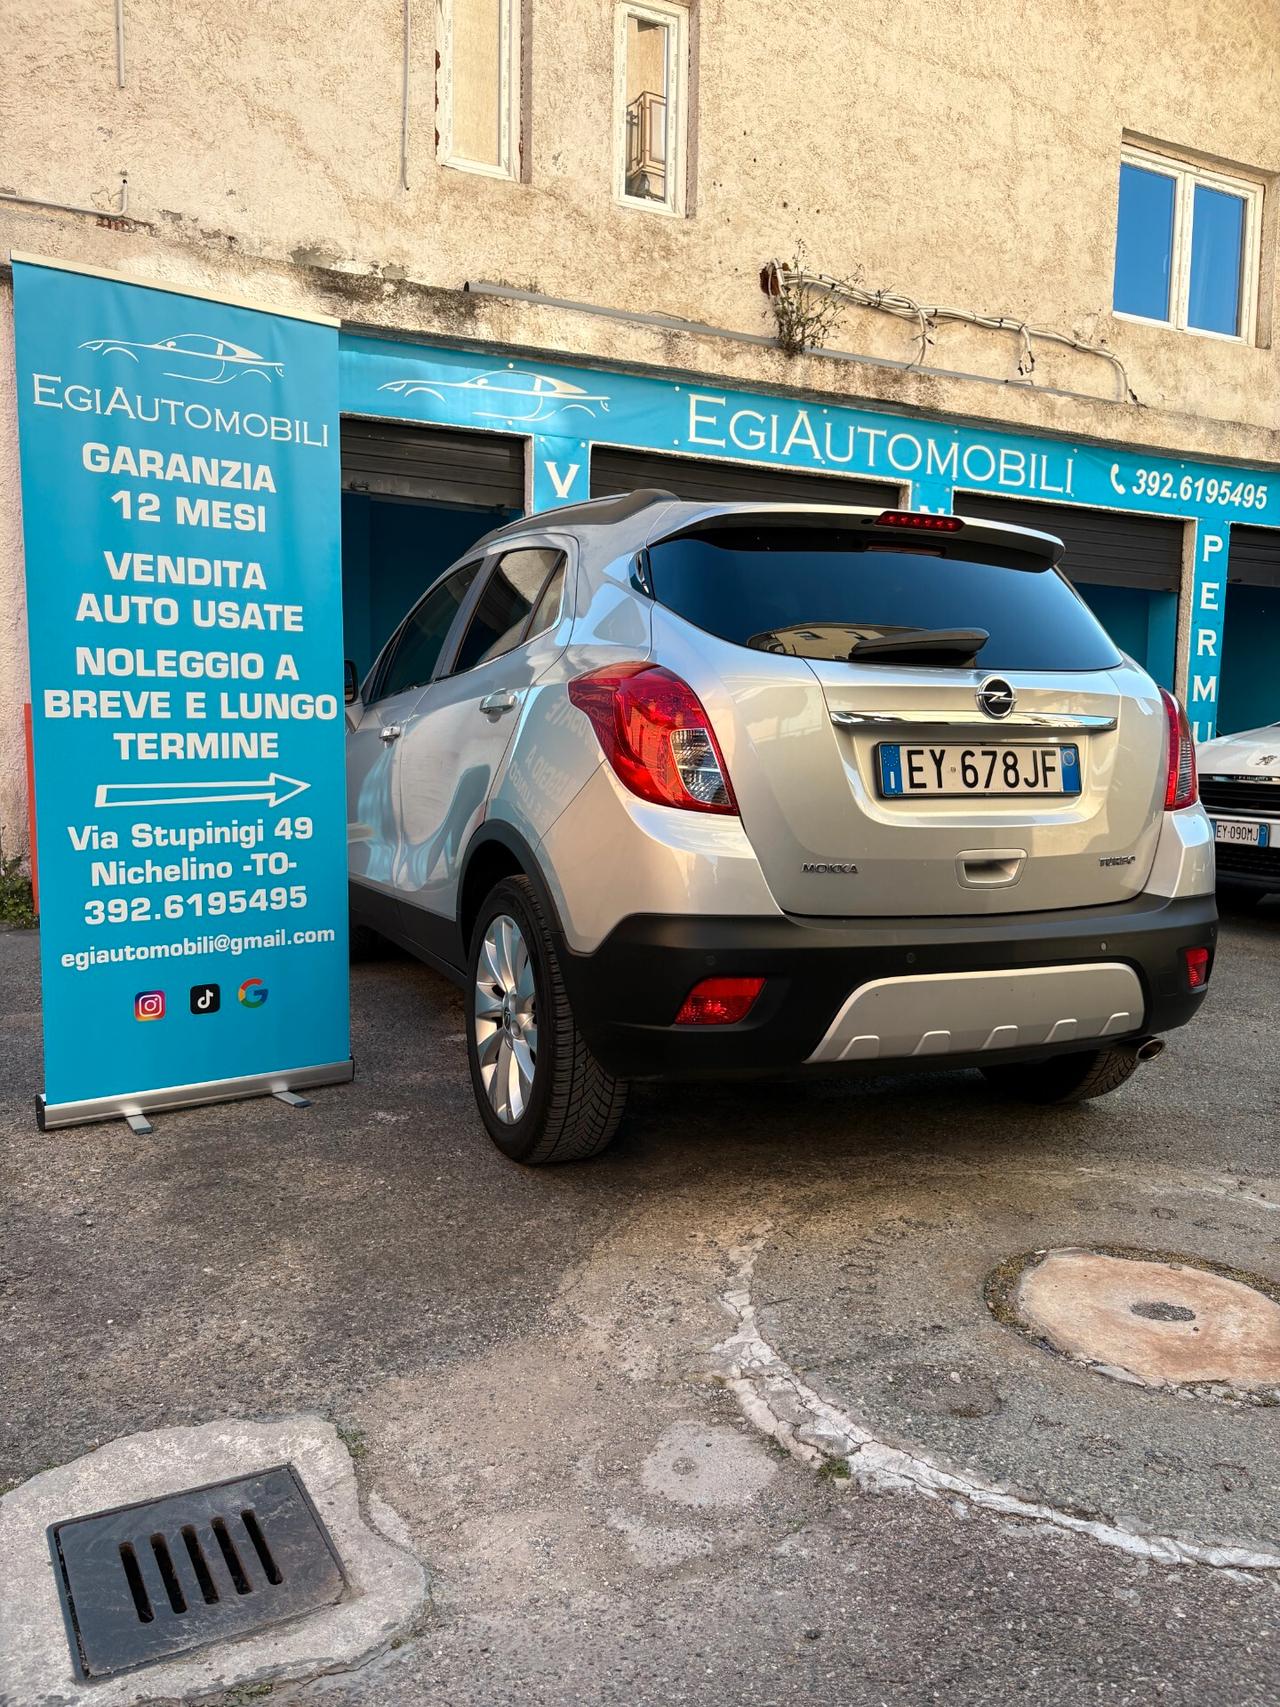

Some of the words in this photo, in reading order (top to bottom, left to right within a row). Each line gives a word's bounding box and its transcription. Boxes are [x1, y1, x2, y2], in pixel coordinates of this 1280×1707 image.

[82, 442, 277, 493] GARANZIA
[1132, 469, 1268, 510] 392.6195495
[111, 490, 161, 523] 12
[175, 498, 266, 533] MESI
[103, 550, 267, 590] VENDITA
[75, 593, 179, 626] AUTO
[193, 599, 304, 632] USATE
[75, 646, 264, 680] NOLEGGIO
[275, 654, 300, 681] A
[44, 689, 171, 719] BREVE
[186, 691, 207, 719] E
[220, 692, 338, 720] LUNGO
[113, 732, 279, 760] TERMINE
[907, 749, 946, 789] EY
[961, 749, 1057, 789] 678JF
[67, 825, 118, 851] Via
[131, 818, 264, 852] Stupinigi
[274, 816, 313, 840] 49
[91, 856, 233, 887] Nichelino
[243, 851, 297, 876] -TO-
[801, 862, 859, 874] MOKKA
[84, 886, 307, 925] 392.6195495
[61, 926, 335, 971] egiautomobili@gmail.com
